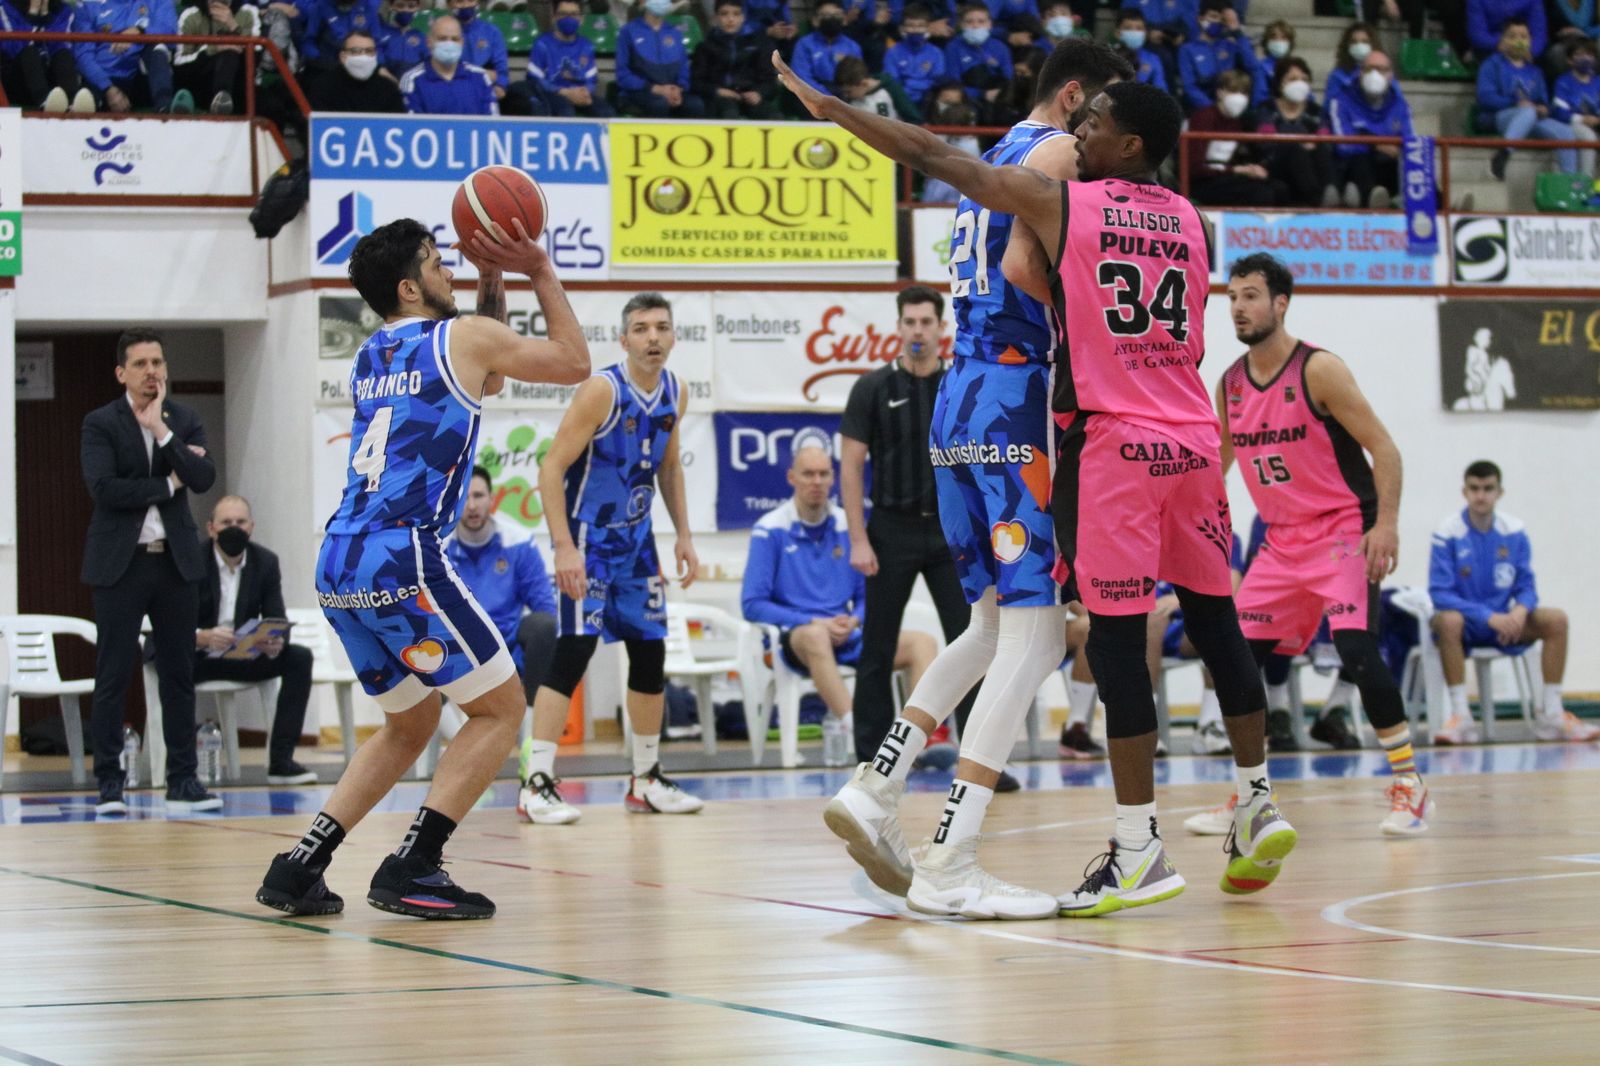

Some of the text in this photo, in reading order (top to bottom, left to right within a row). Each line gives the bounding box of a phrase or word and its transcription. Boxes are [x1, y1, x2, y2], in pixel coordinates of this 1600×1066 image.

[319, 127, 600, 172] GASOLINERA
[629, 127, 872, 171] POLLOS
[620, 174, 878, 229] JOAQUIN
[661, 228, 849, 243] SERVICIO DE CATERING
[1102, 207, 1181, 234] ELLISOR
[620, 246, 887, 261] COMIDAS CASERAS PARA LLEVAR
[949, 207, 991, 297] 21
[1100, 231, 1189, 262] PULEVA
[1097, 261, 1188, 342] 34
[716, 313, 801, 335] Bombones
[1540, 309, 1575, 345] El
[1125, 359, 1140, 371] DE
[321, 381, 345, 398] Pol.
[688, 381, 712, 398] 783
[351, 406, 395, 493] 4
[1120, 443, 1174, 462] CAJA
[1253, 455, 1292, 486] 15
[647, 576, 664, 609] 5
[1091, 577, 1140, 588] Granada
[1101, 588, 1140, 602] Digital
